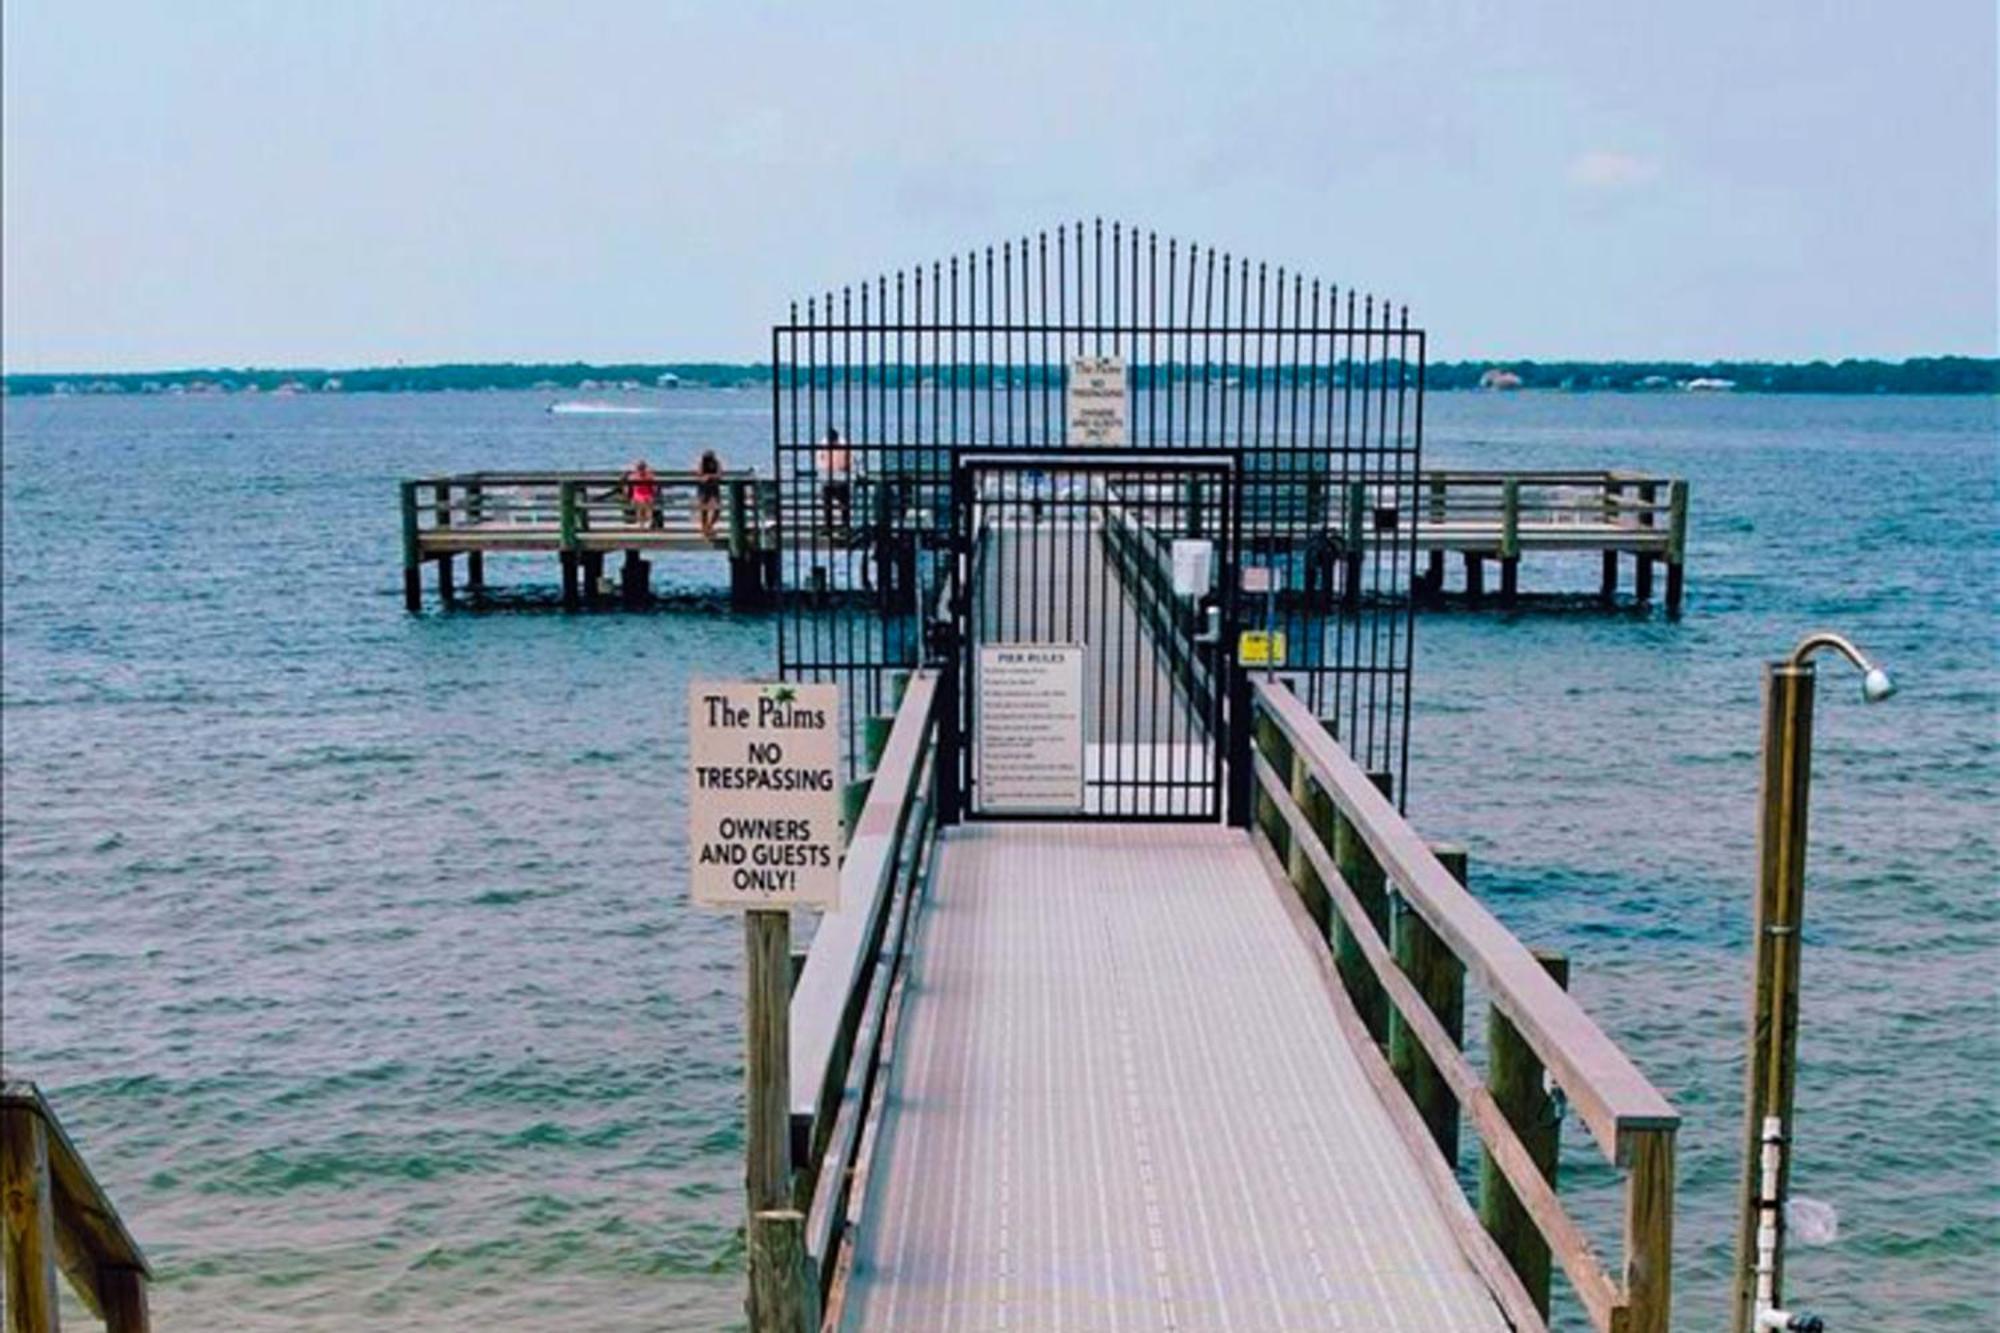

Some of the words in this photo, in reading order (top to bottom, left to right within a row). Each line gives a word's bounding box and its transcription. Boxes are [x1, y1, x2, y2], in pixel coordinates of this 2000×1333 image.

[997, 653, 1024, 663] PIER
[703, 695, 750, 729] The
[758, 696, 826, 730] Palms
[749, 742, 782, 765] NO
[696, 766, 833, 791] TRESPASSING
[719, 817, 811, 842] OWNERS
[699, 843, 747, 866] AND
[752, 844, 831, 867] GUESTS
[733, 868, 796, 892] ONLY!
